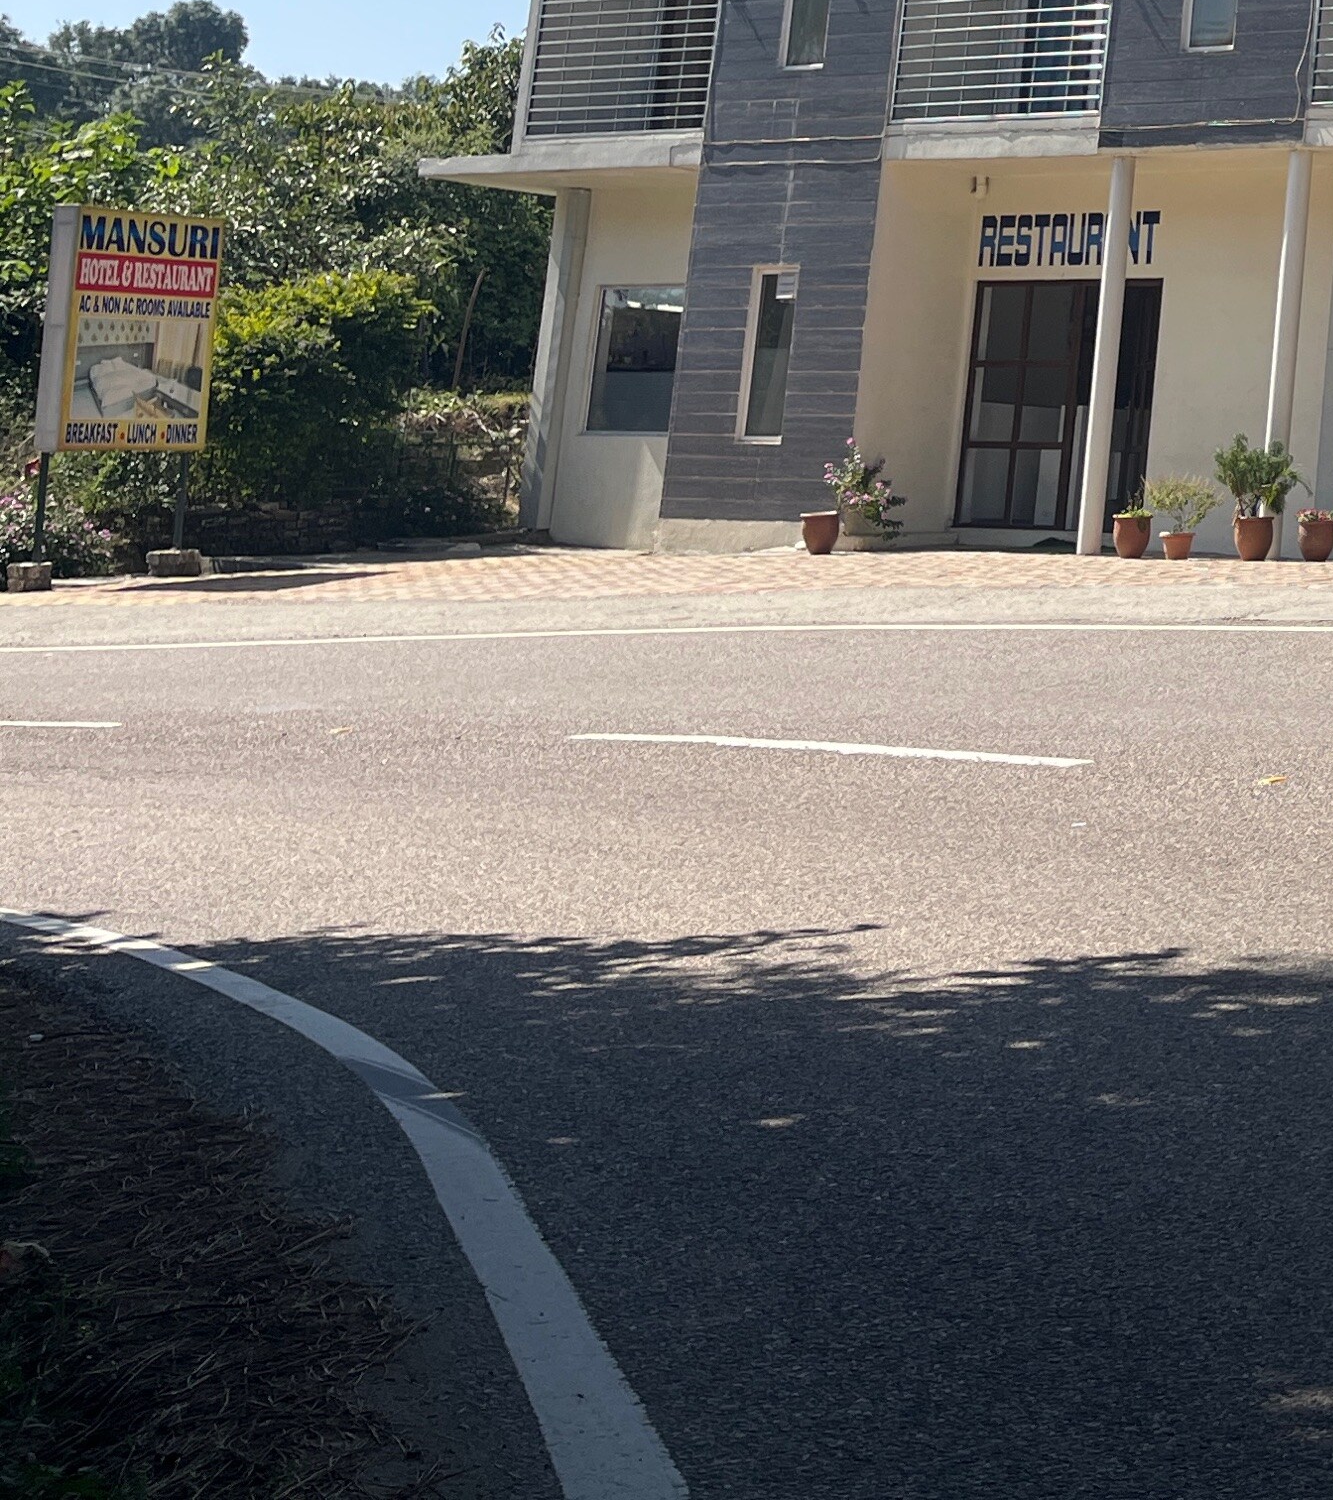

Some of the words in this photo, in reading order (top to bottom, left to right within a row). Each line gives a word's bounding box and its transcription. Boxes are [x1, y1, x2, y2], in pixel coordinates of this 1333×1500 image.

[80, 215, 220, 259] MANSURI
[978, 211, 1161, 267] RESTAURNT
[79, 258, 120, 286] HOTEL
[122, 260, 133, 287] &
[133, 262, 214, 292] RESTAURANT
[79, 295, 91, 312] AC
[93, 295, 99, 313] &
[101, 296, 121, 314] NON
[122, 299, 134, 315] AC
[136, 299, 165, 316] ROOMS
[167, 301, 211, 318] AVAILABLE
[65, 423, 118, 444] BREAKFAST
[127, 423, 157, 444] LUNCH
[165, 424, 198, 444] DINNER
